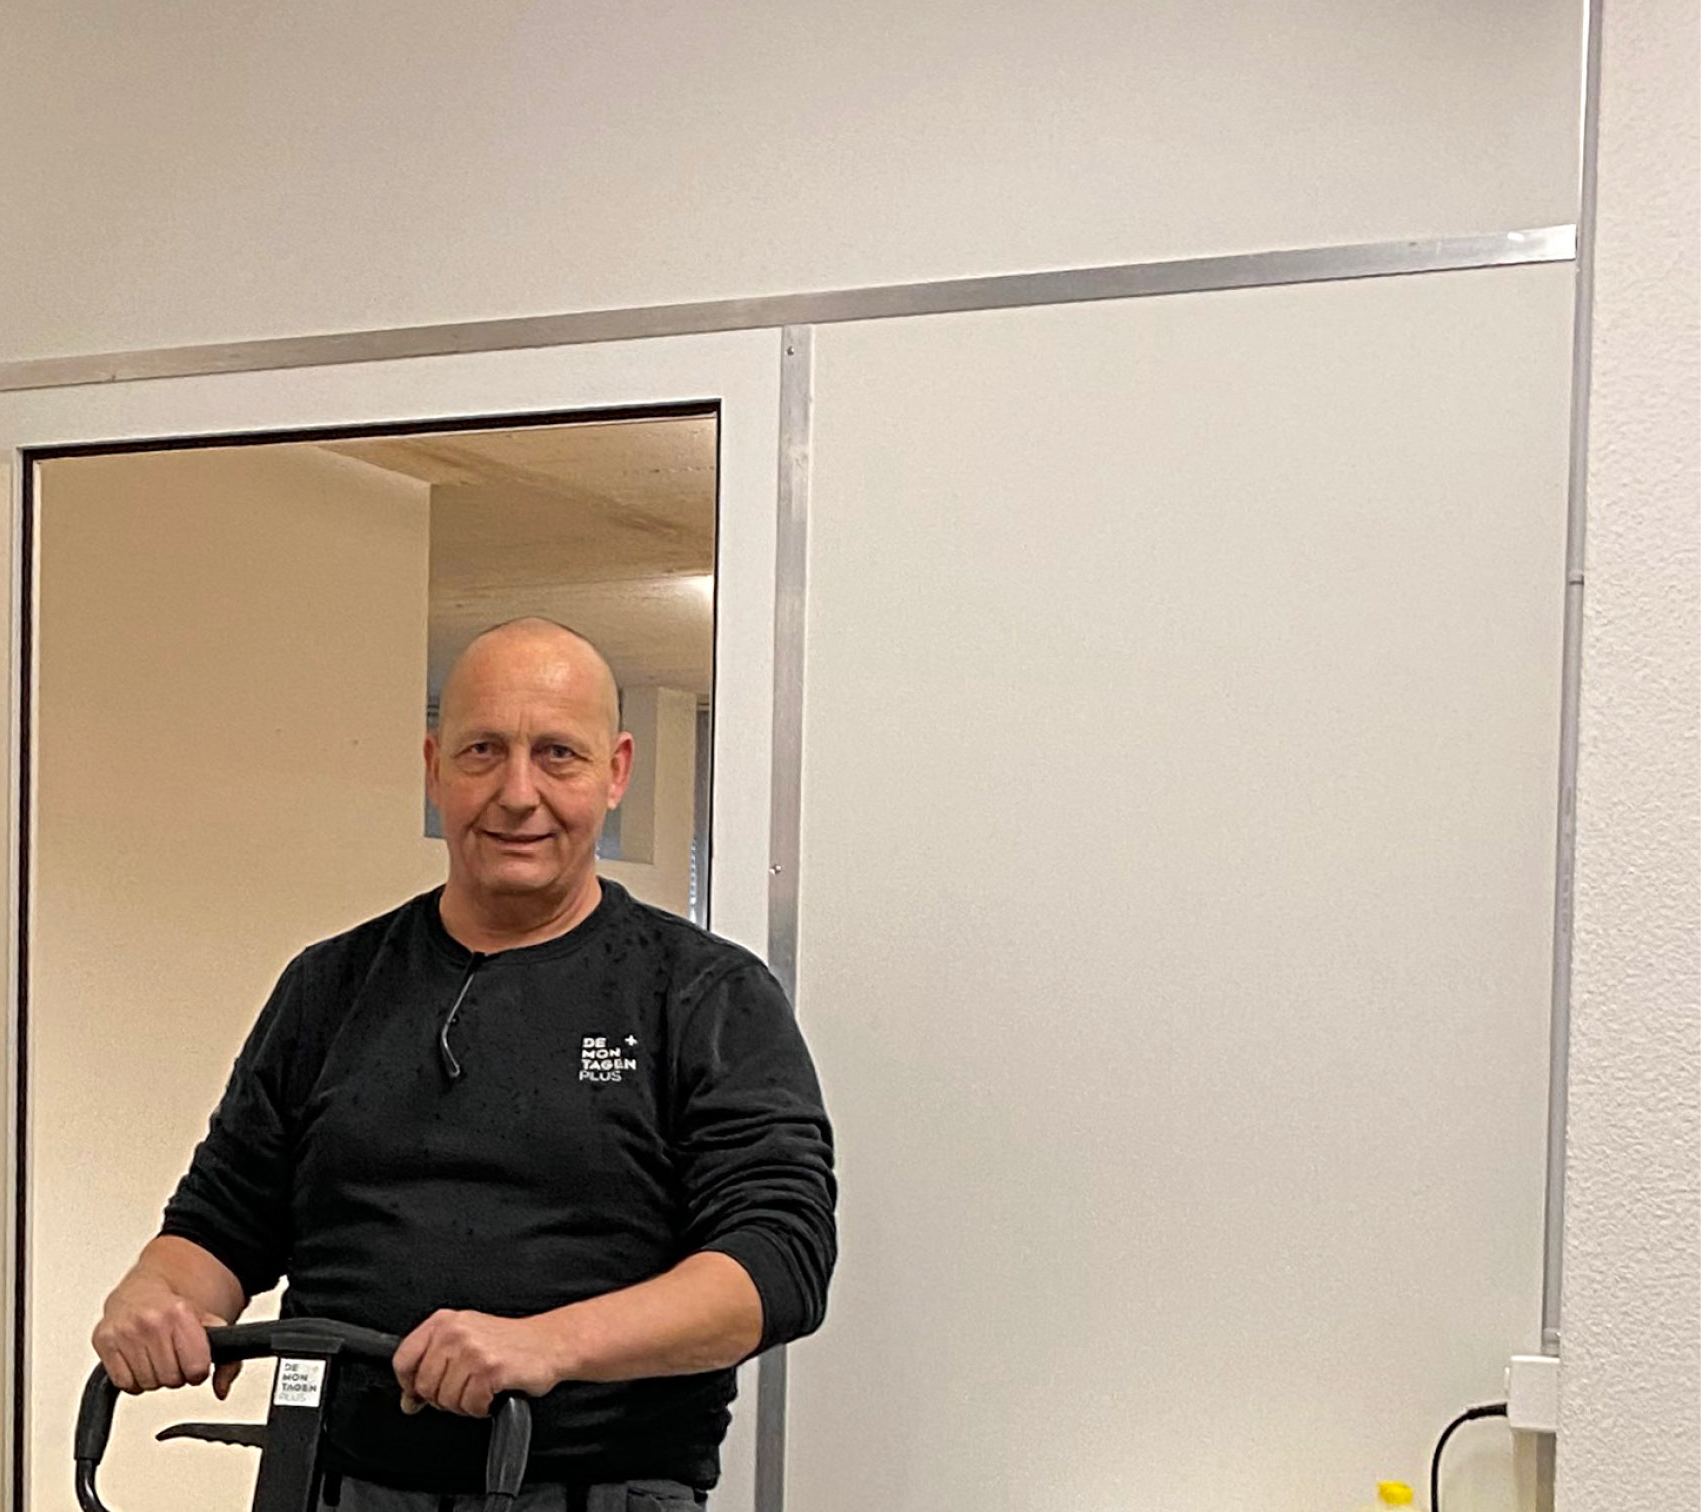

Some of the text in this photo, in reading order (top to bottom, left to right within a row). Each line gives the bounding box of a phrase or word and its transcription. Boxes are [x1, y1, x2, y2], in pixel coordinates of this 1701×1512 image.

[582, 1037, 607, 1048] DE
[581, 1047, 621, 1059] MON
[581, 1059, 637, 1070] TAGEN
[579, 1070, 622, 1082] PLUS
[282, 1373, 308, 1381] MON
[281, 1383, 317, 1392] TAGEN
